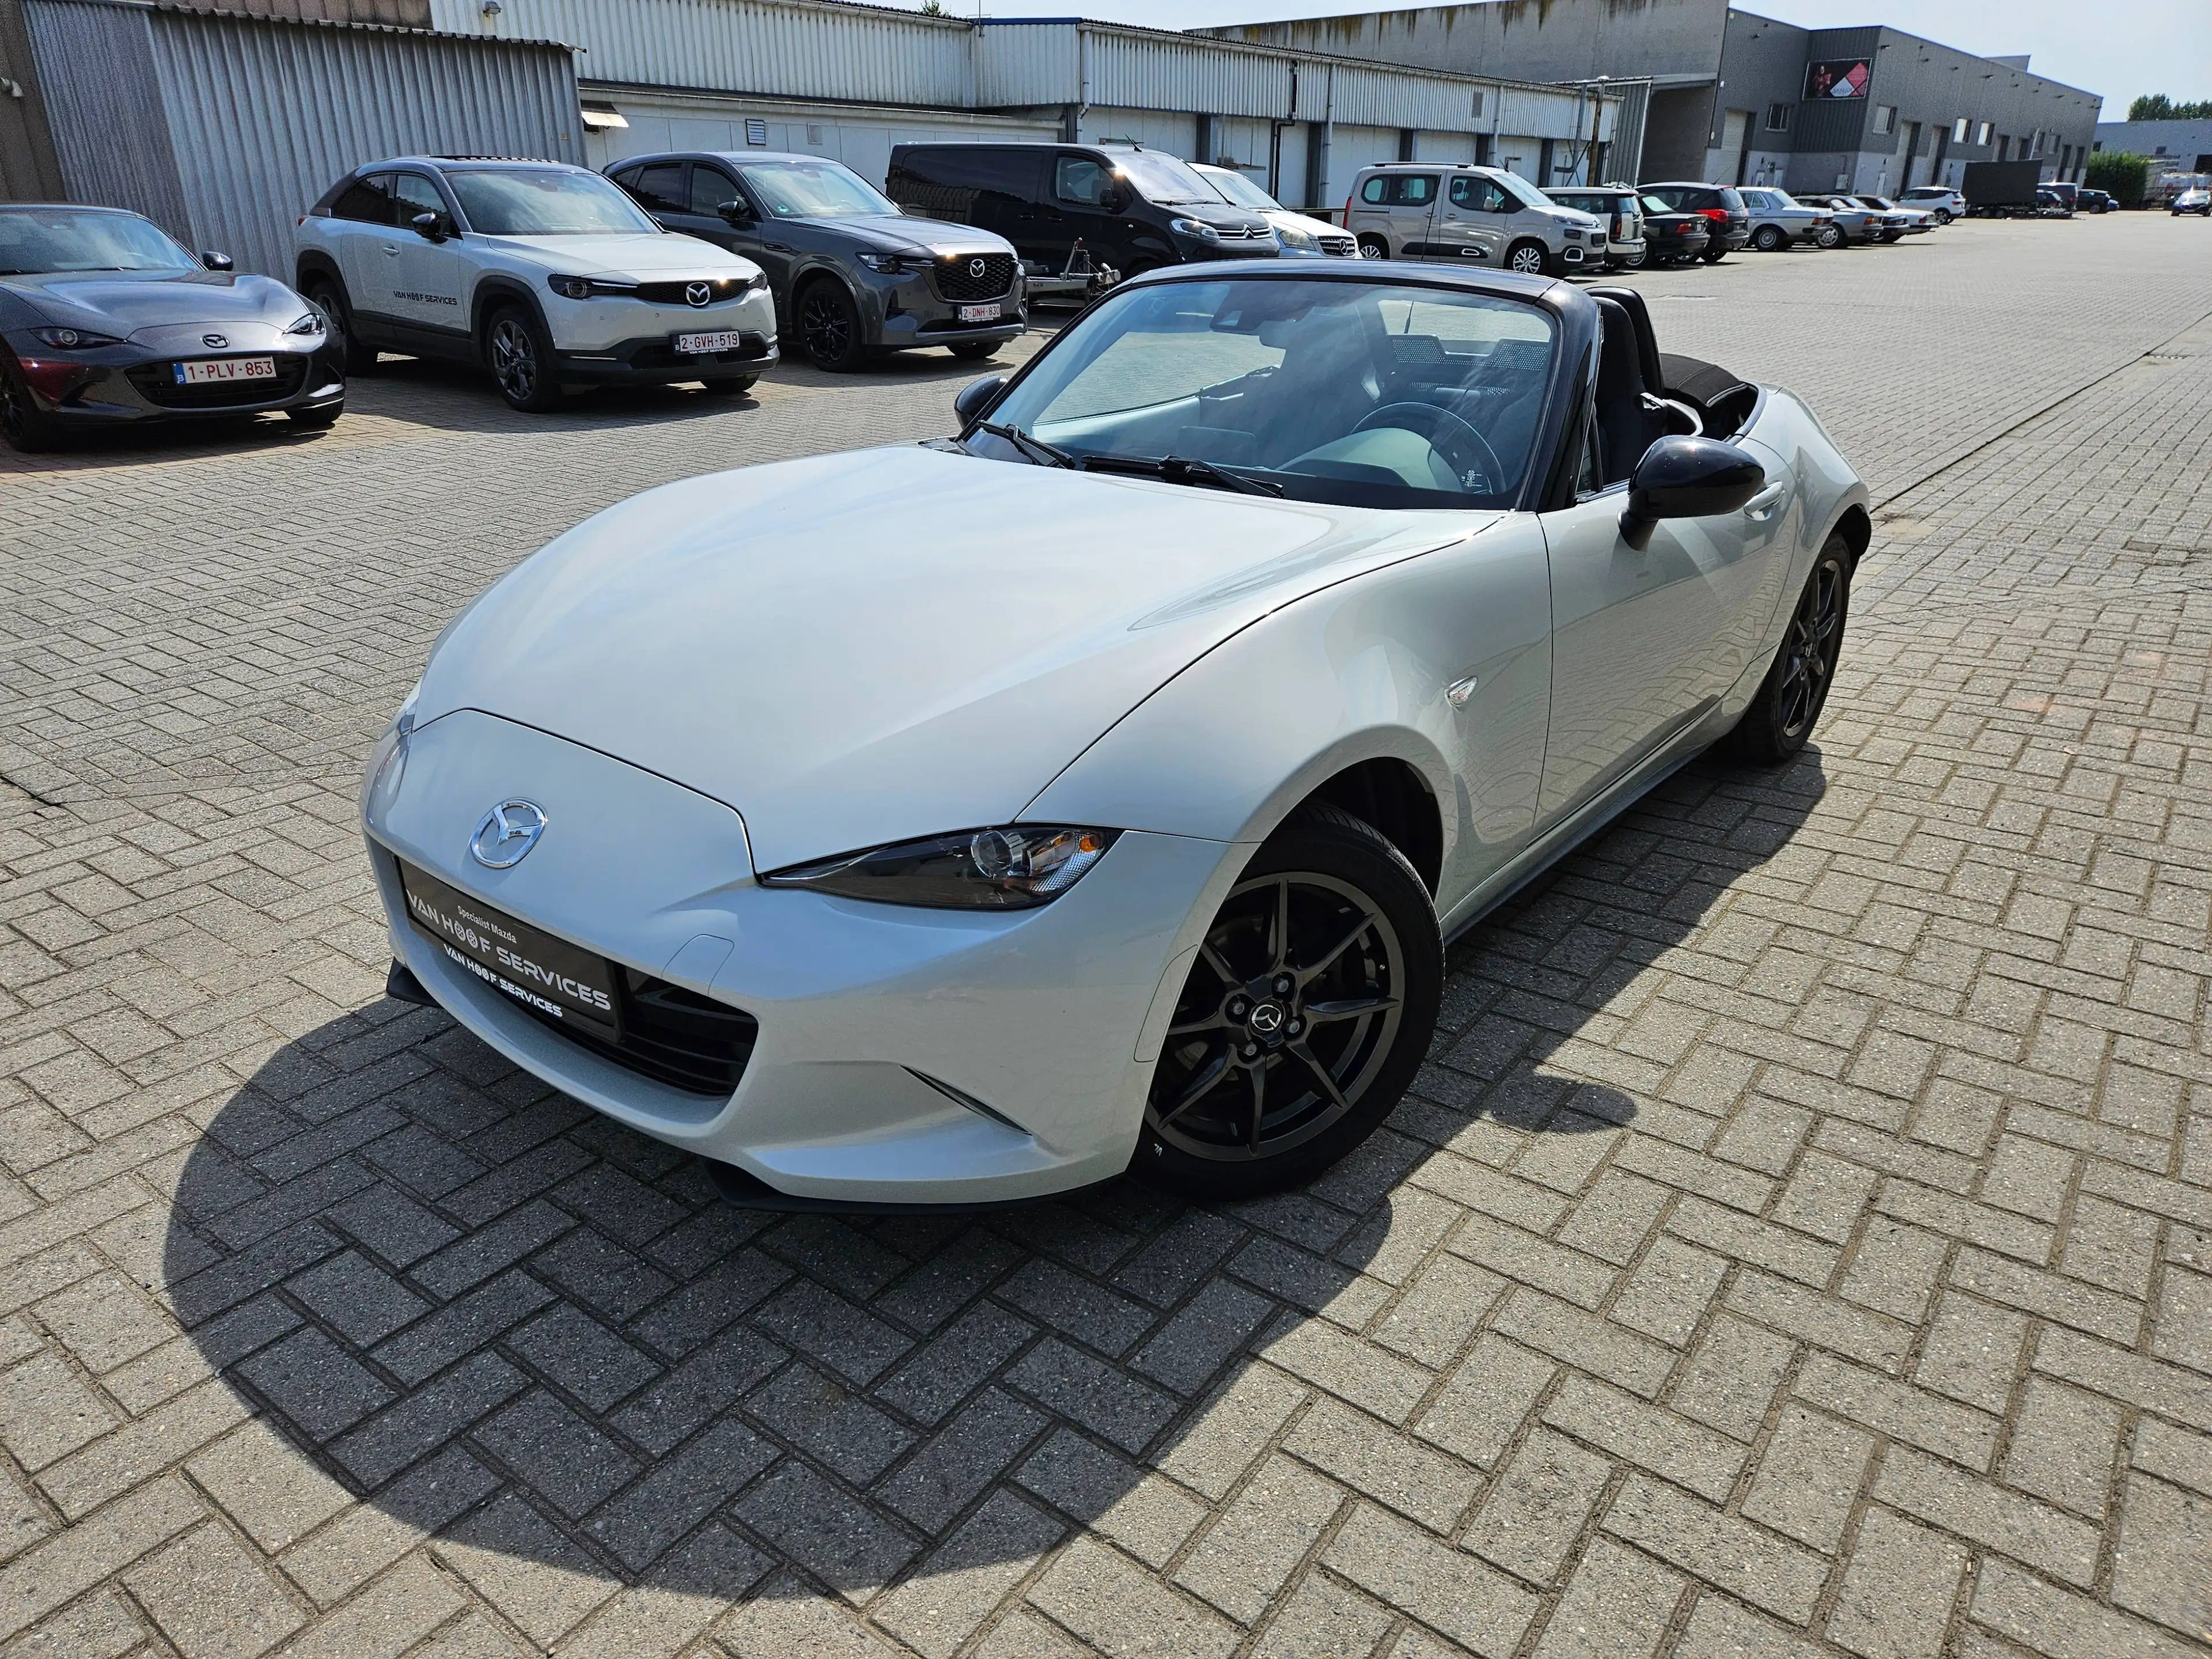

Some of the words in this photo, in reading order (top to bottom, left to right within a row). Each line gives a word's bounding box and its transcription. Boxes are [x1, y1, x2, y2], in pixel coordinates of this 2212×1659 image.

[393, 290, 407, 299] VAN
[425, 295, 458, 306] SERVICES
[681, 334, 738, 350] 2-GVH-519
[188, 361, 273, 380] 1-PLV-853
[457, 905, 490, 931] Specialist
[491, 922, 517, 944] Mazda
[406, 889, 440, 925] VAN
[441, 913, 491, 953] HOOF
[496, 946, 611, 1010] SERVICES
[443, 943, 466, 966] VAN
[499, 978, 563, 1018] SERVICES
